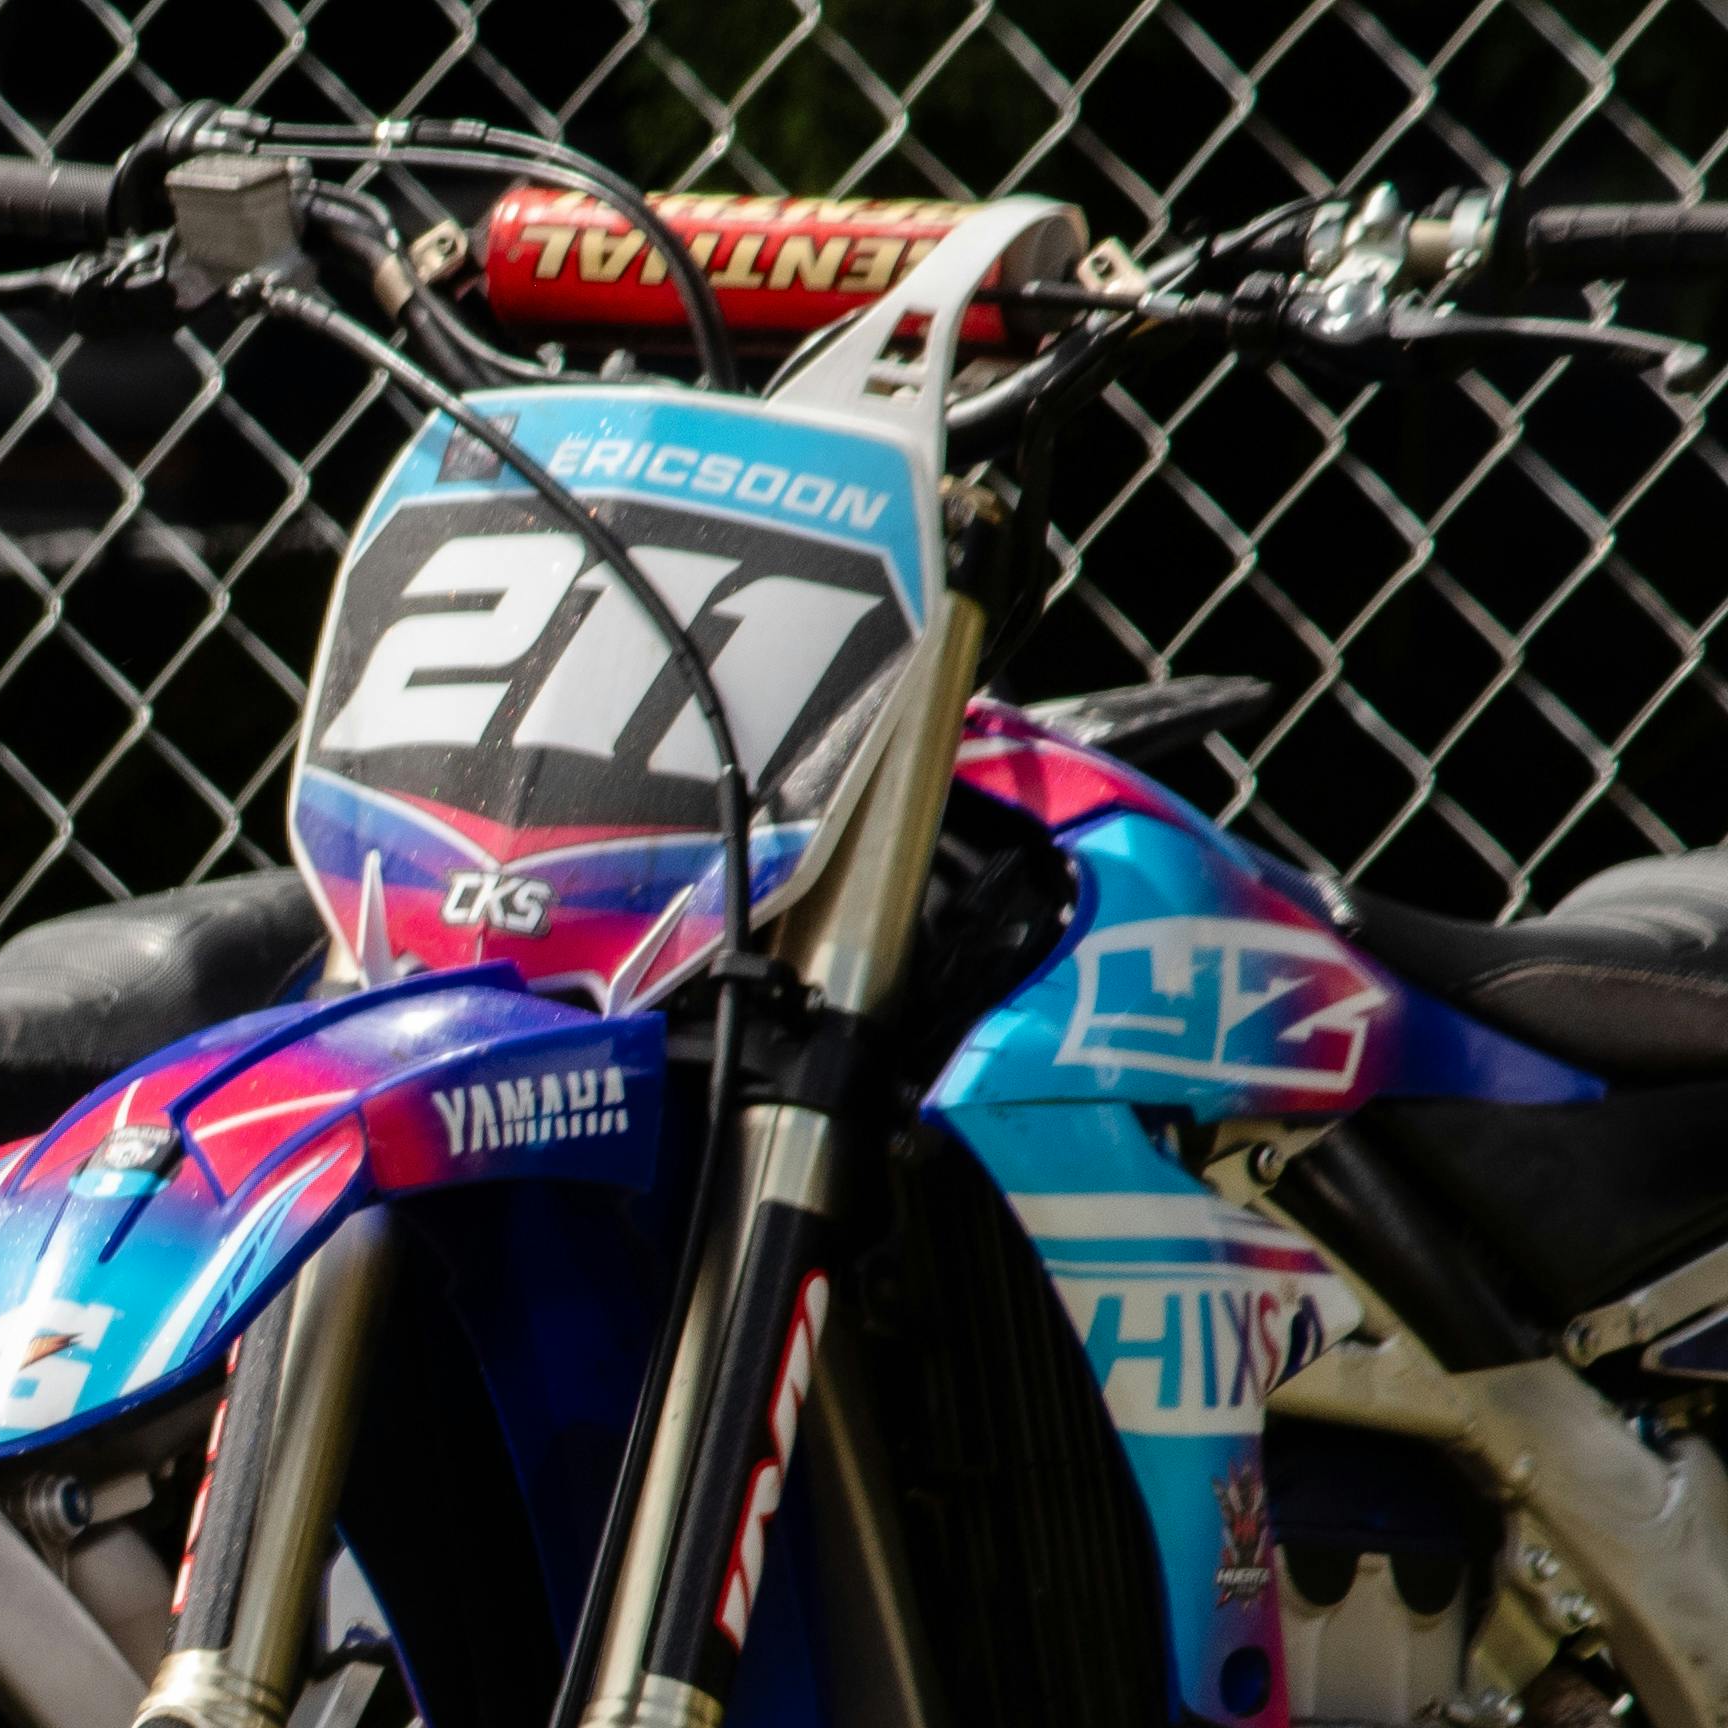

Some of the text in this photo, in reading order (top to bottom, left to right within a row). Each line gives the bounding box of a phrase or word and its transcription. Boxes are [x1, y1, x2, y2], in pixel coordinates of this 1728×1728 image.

[546, 436, 894, 531] ERICSOON
[320, 532, 886, 784] 211
[441, 870, 554, 932] CKS
[432, 1066, 629, 1157] YAMAHA
